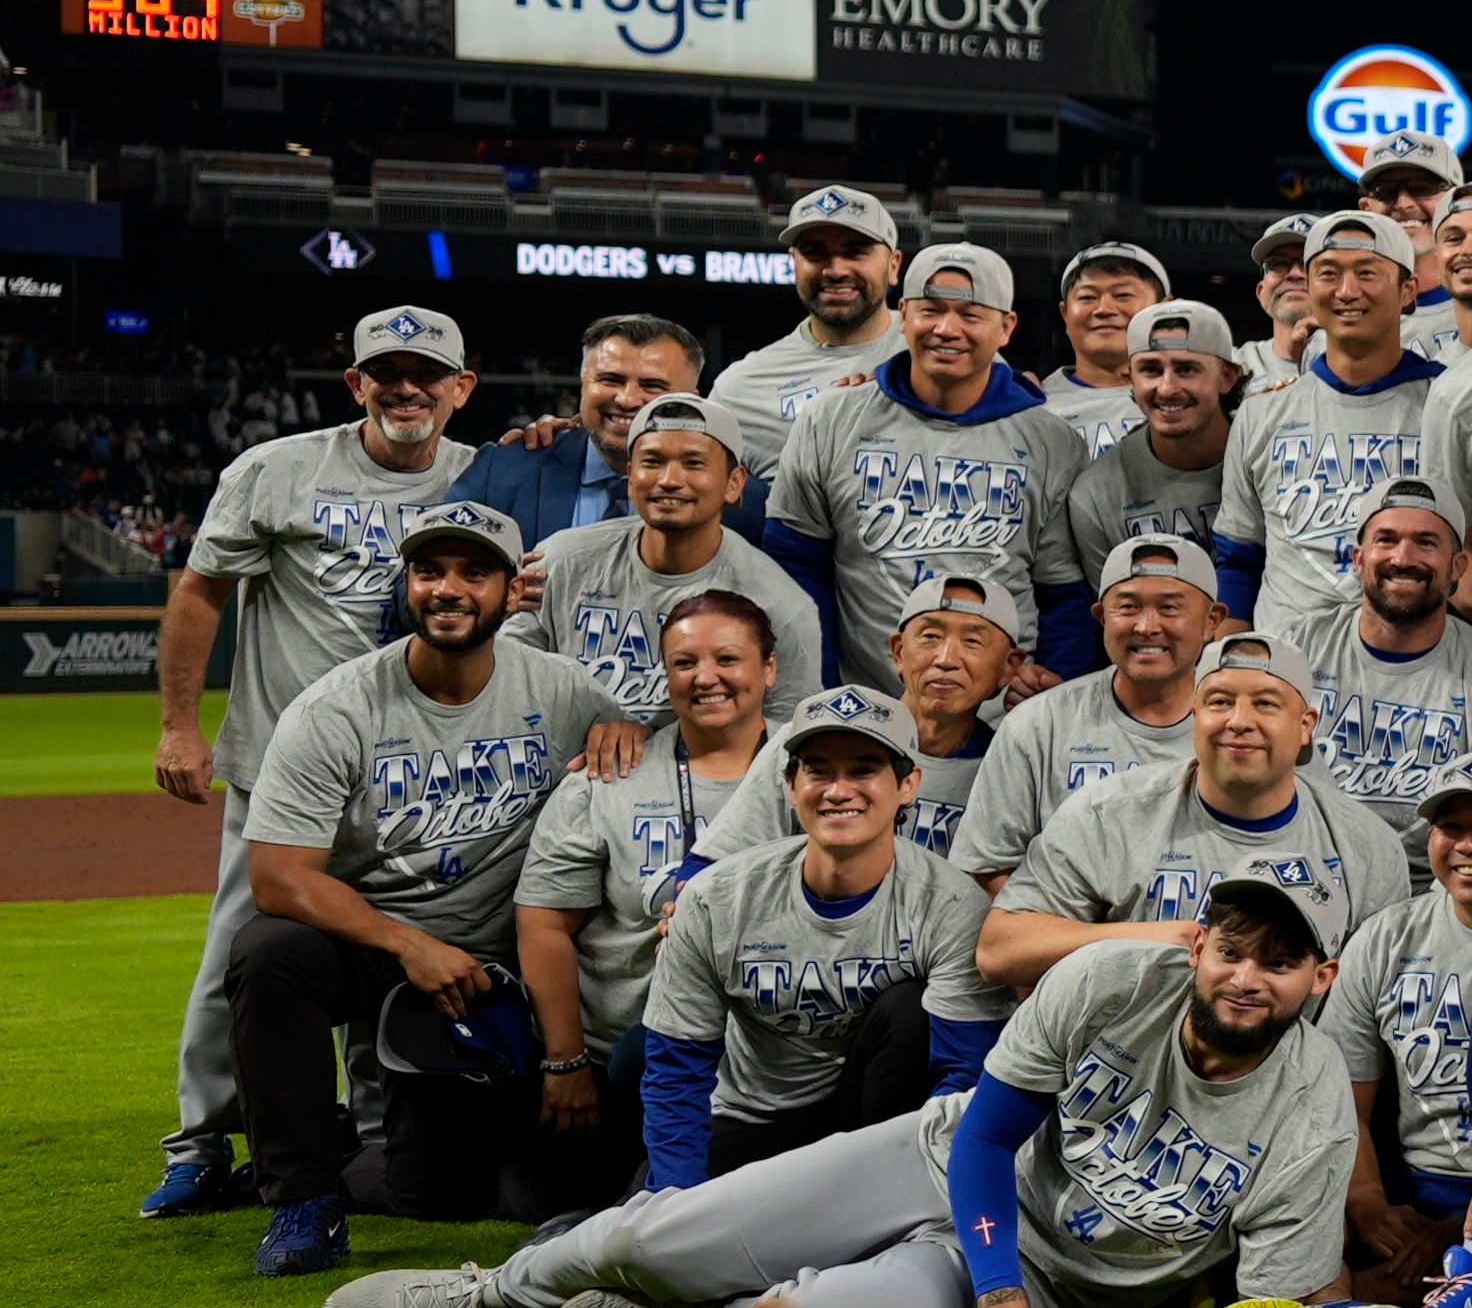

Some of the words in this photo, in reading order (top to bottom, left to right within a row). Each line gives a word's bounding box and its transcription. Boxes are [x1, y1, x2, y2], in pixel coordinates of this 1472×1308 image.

[88, 11, 219, 41] MILLION
[833, 28, 1044, 63] HEALTHCARE
[1322, 97, 1457, 137] Gulf
[517, 243, 648, 279] DODGERS
[396, 314, 417, 336] LA
[854, 449, 1027, 524] TAKE
[314, 501, 427, 553] TA
[858, 499, 1018, 557] October
[839, 693, 858, 713] LA
[373, 733, 553, 818] TAKE
[376, 780, 538, 852] October
[436, 847, 470, 884] LA
[1282, 861, 1304, 885] LA
[1056, 1049, 1252, 1233] TAKE
[1064, 1205, 1101, 1244] LA
